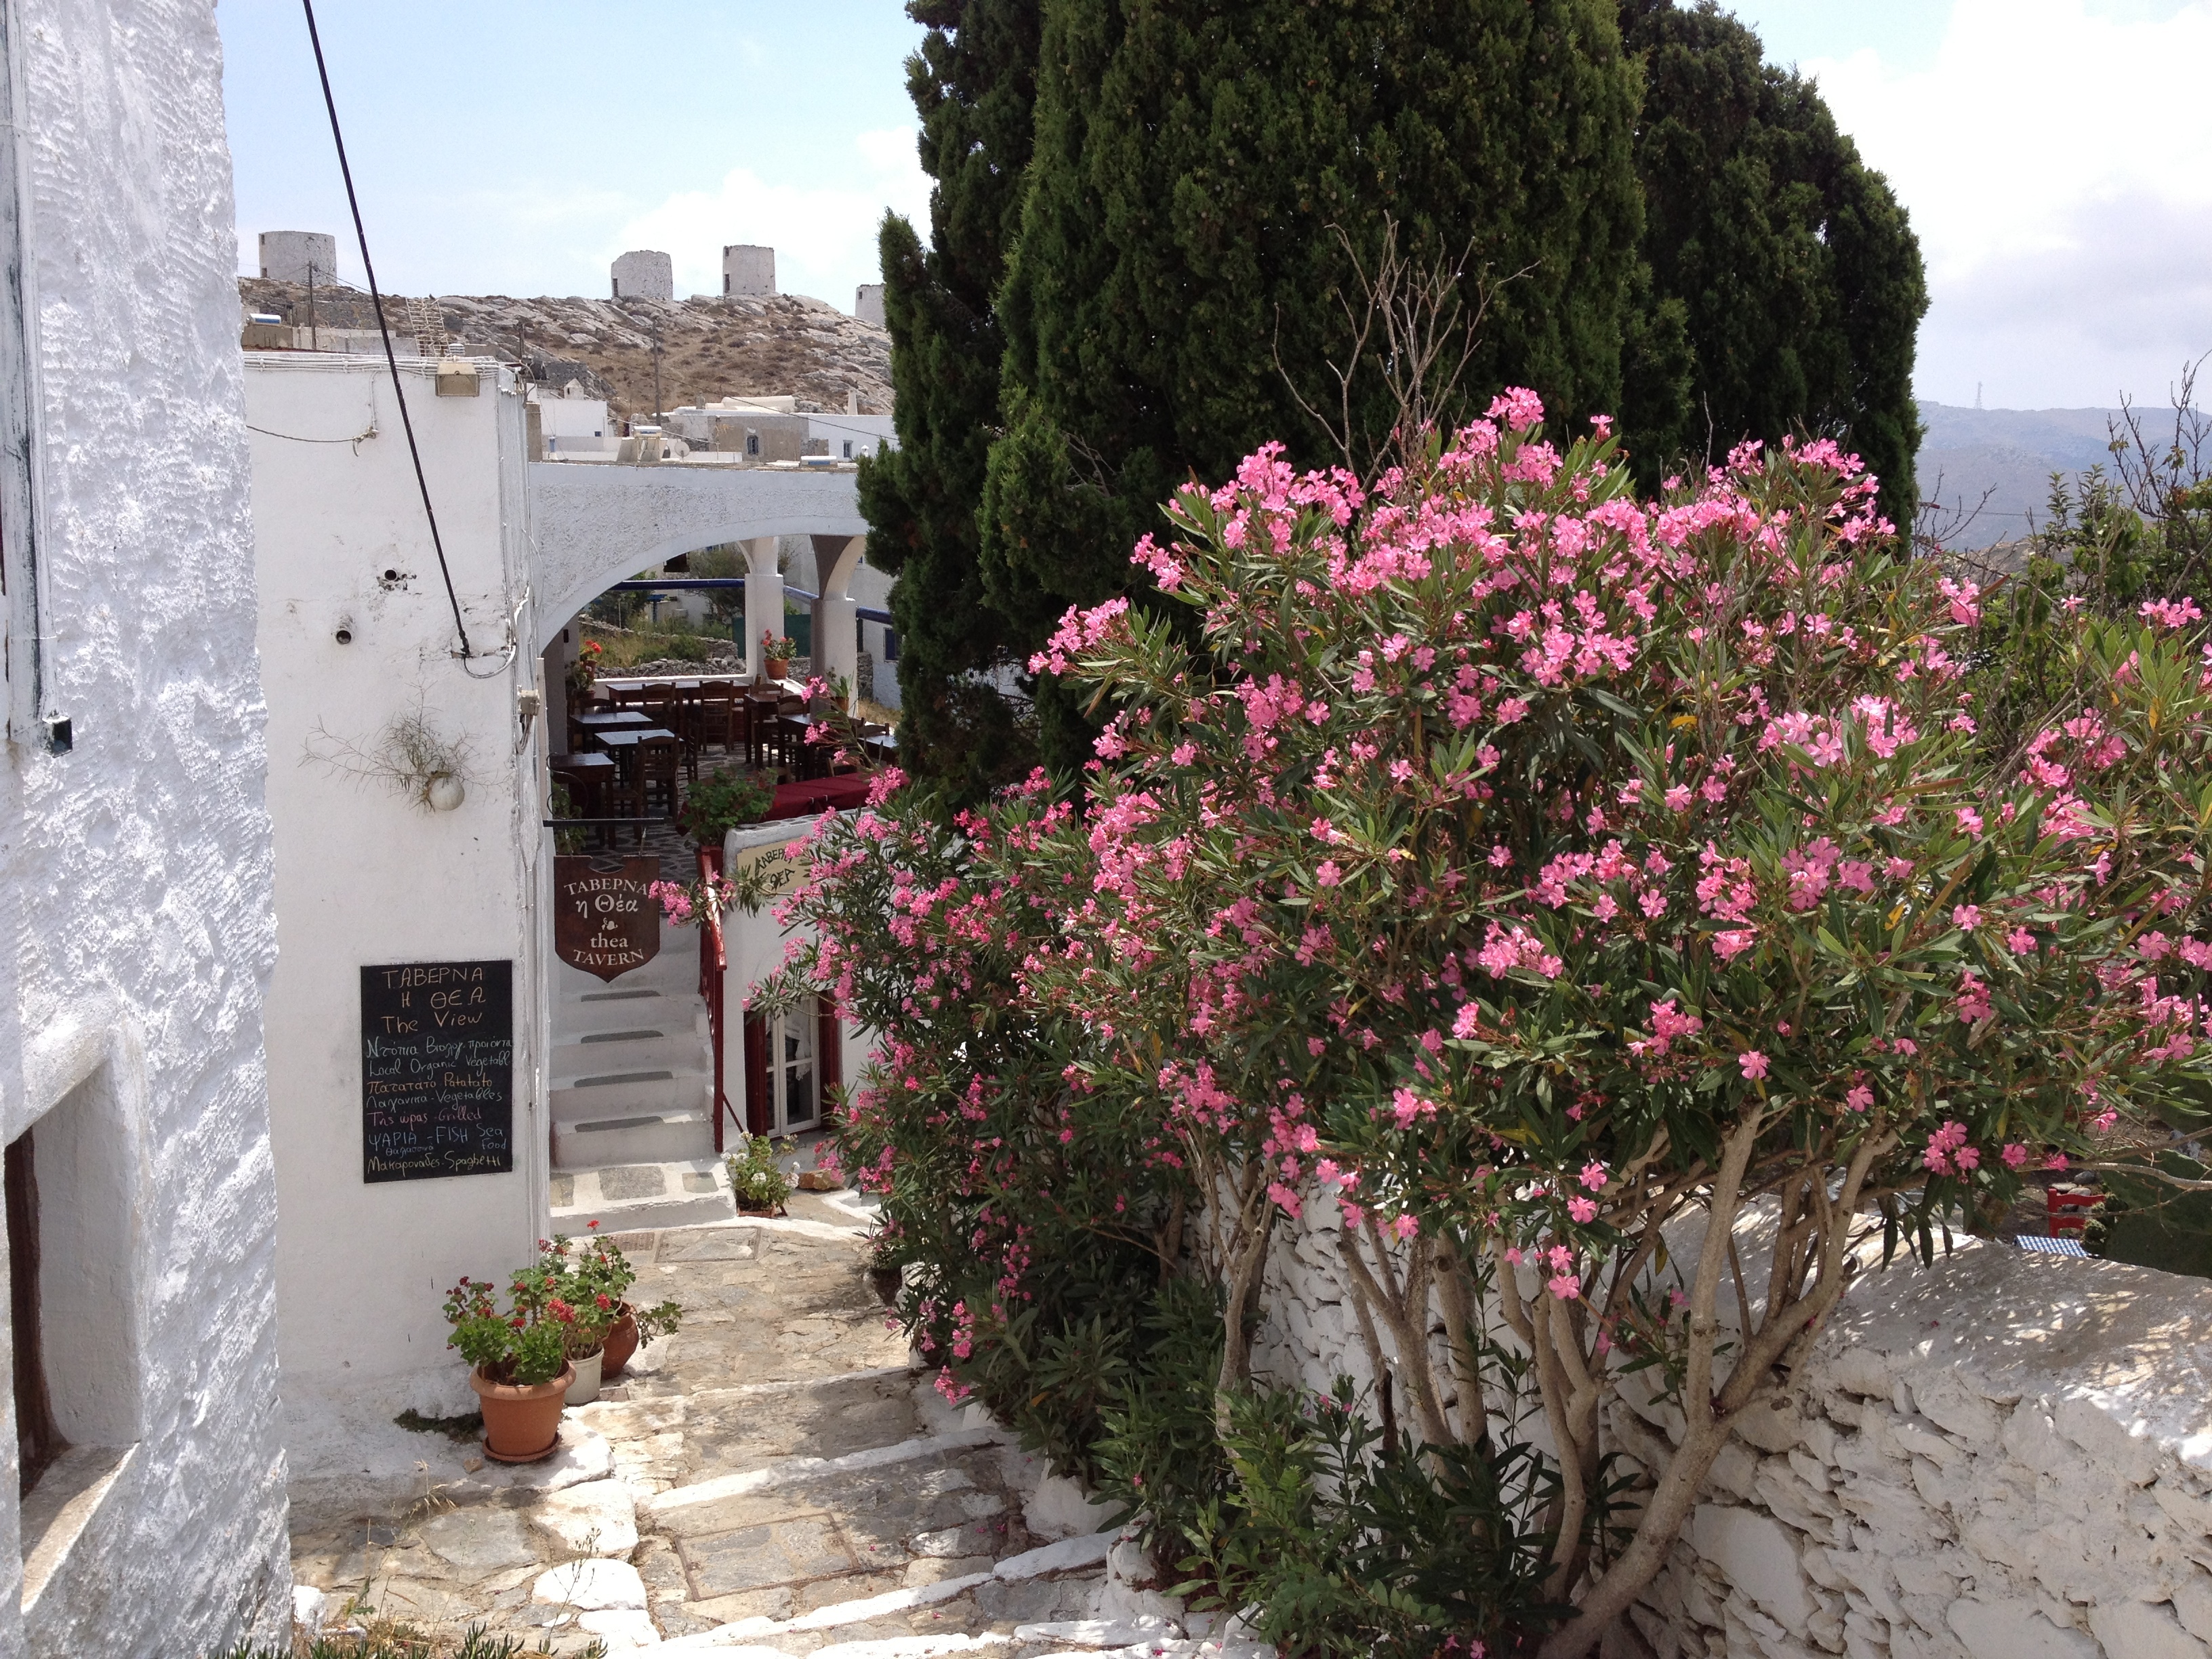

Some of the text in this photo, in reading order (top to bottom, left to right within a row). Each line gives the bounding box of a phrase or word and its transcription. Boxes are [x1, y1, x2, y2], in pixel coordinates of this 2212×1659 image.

[564, 878, 647, 895] ΤΑΒΕΡΝΑ
[576, 894, 638, 918] η Θέα
[590, 933, 628, 947] thea
[573, 949, 644, 965] TAVERN
[382, 968, 483, 989] ΤΑΒΕΡΝΑ
[430, 987, 487, 1008] ΘΕΑ
[381, 1010, 483, 1033] The View
[369, 1059, 401, 1077] Local
[410, 1059, 456, 1080] Organic
[369, 1132, 417, 1151] ΨΑΡΙΑ
[436, 1126, 468, 1144] FISH
[476, 1123, 504, 1137] Sea
[482, 1138, 507, 1149] Food
[445, 1151, 501, 1172] Spaghetti
